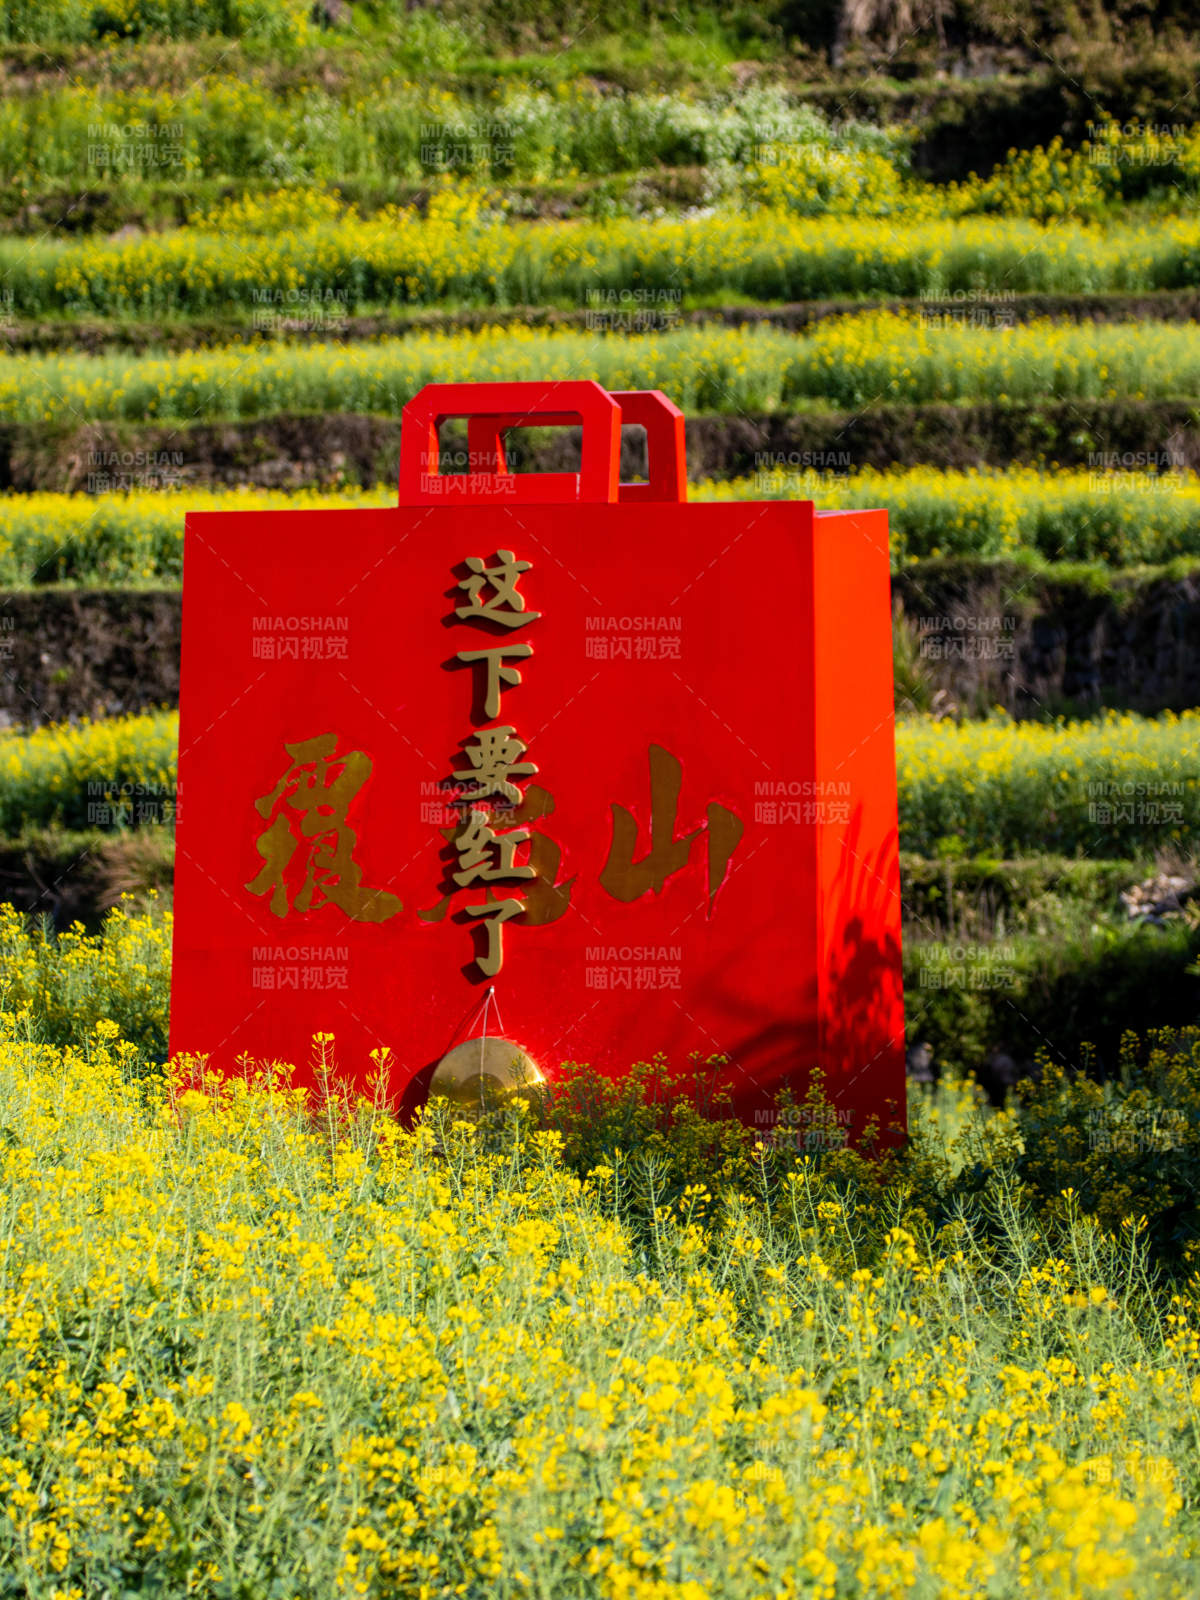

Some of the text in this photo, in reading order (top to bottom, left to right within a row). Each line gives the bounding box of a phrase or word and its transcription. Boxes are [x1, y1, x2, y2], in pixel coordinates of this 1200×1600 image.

[453, 549, 541, 977] 这下要红了
